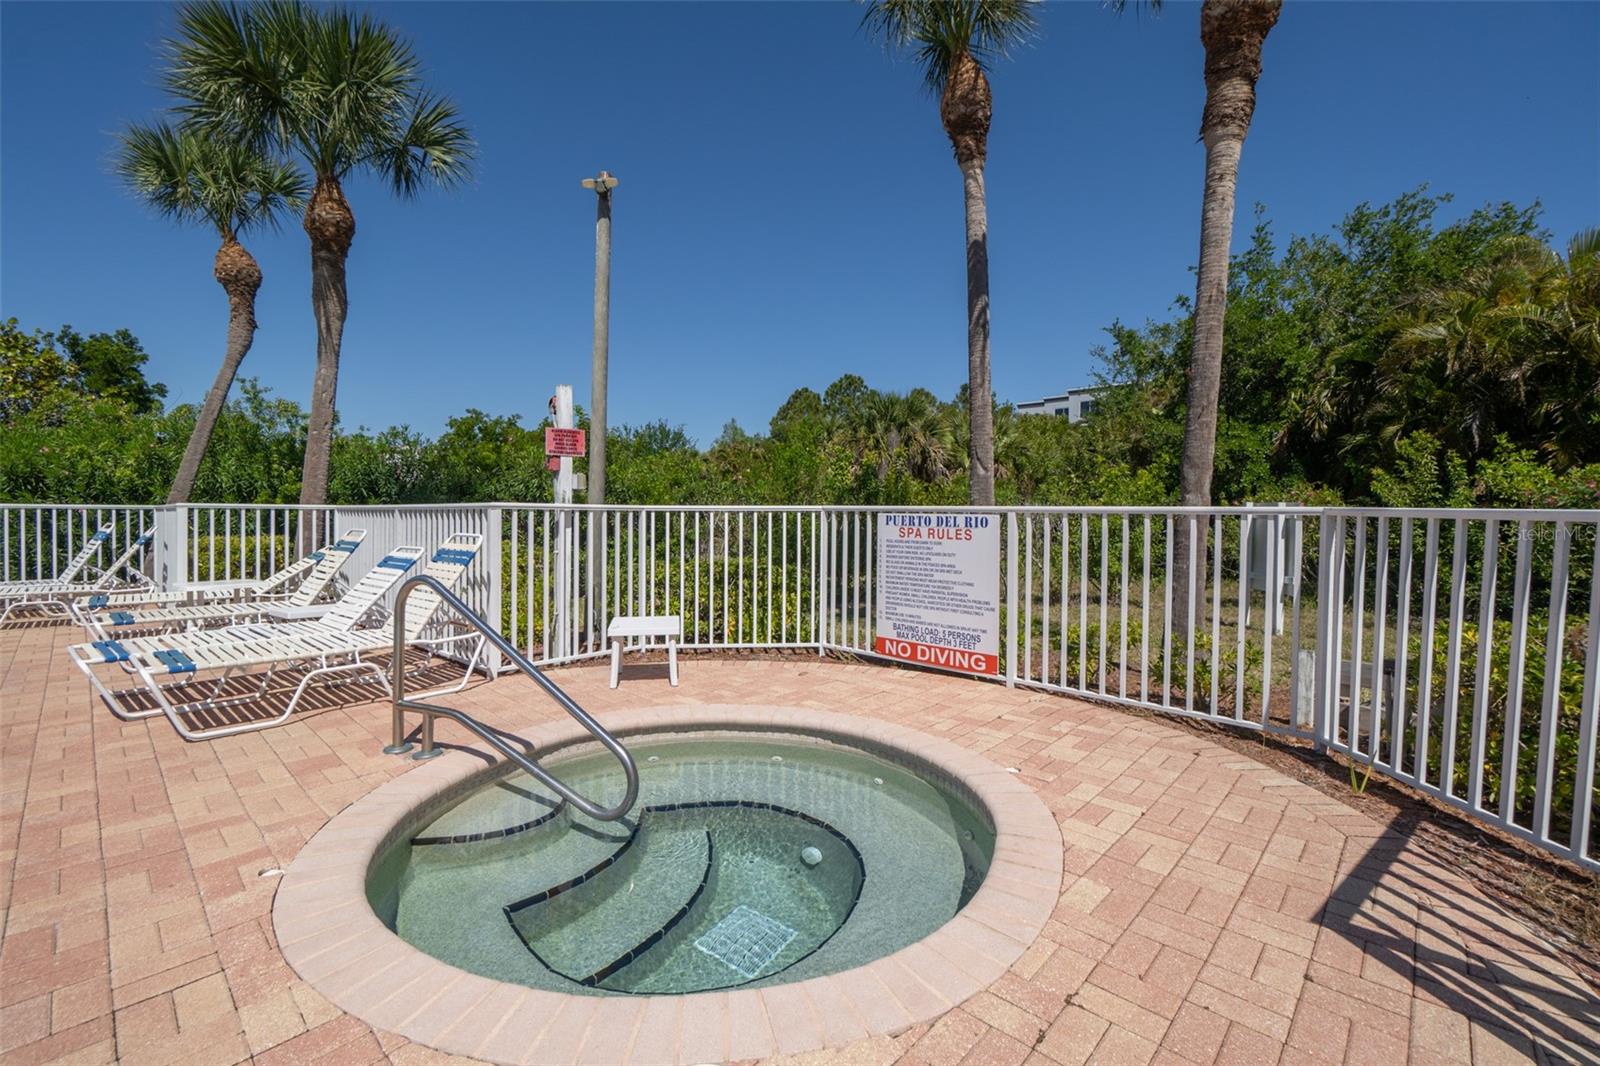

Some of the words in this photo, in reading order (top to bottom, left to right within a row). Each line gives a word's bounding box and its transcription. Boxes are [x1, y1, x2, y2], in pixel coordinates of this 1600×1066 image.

[886, 515, 931, 528] PUERTO
[936, 516, 960, 528] DEL
[965, 516, 988, 528] RIO
[899, 528, 922, 538] SPA
[928, 528, 973, 540] RULES
[892, 622, 919, 634] BATHING
[942, 630, 946, 638] 5
[947, 630, 981, 643] PERSONS
[896, 630, 910, 639] MAX
[910, 632, 928, 642] POOL
[930, 635, 952, 646] DEPTH
[953, 639, 956, 647] 3
[958, 640, 976, 650] FEET
[885, 642, 911, 657] NO
[917, 647, 986, 671] DIVING
